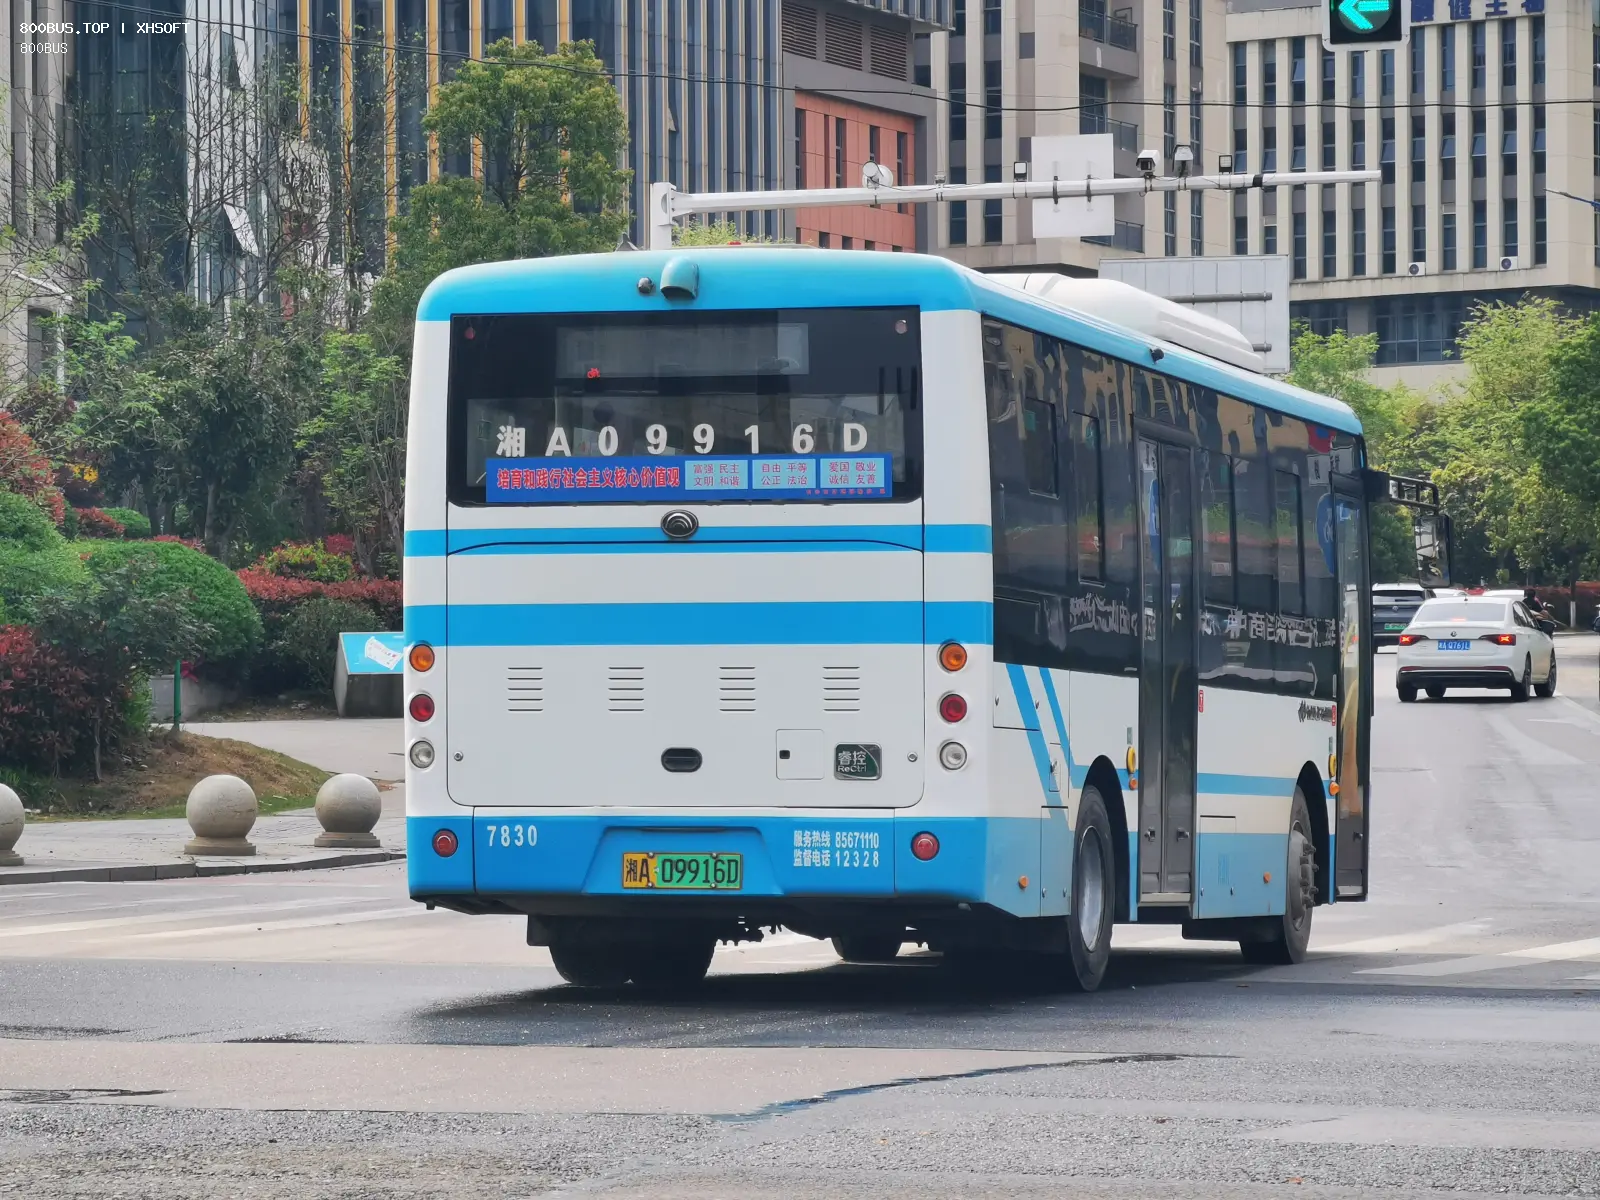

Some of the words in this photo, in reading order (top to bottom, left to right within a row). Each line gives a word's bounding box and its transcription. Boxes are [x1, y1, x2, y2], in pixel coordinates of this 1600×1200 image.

[497, 467, 680, 489] 培育和践行社会主义核心价值观
[838, 750, 867, 766] 睿控
[837, 765, 867, 773] ReCtrl
[486, 824, 538, 847] 7830
[793, 830, 831, 848] 服务热线
[835, 831, 880, 849] 85671110
[793, 848, 831, 867] 监督电话
[835, 850, 880, 868] 12328
